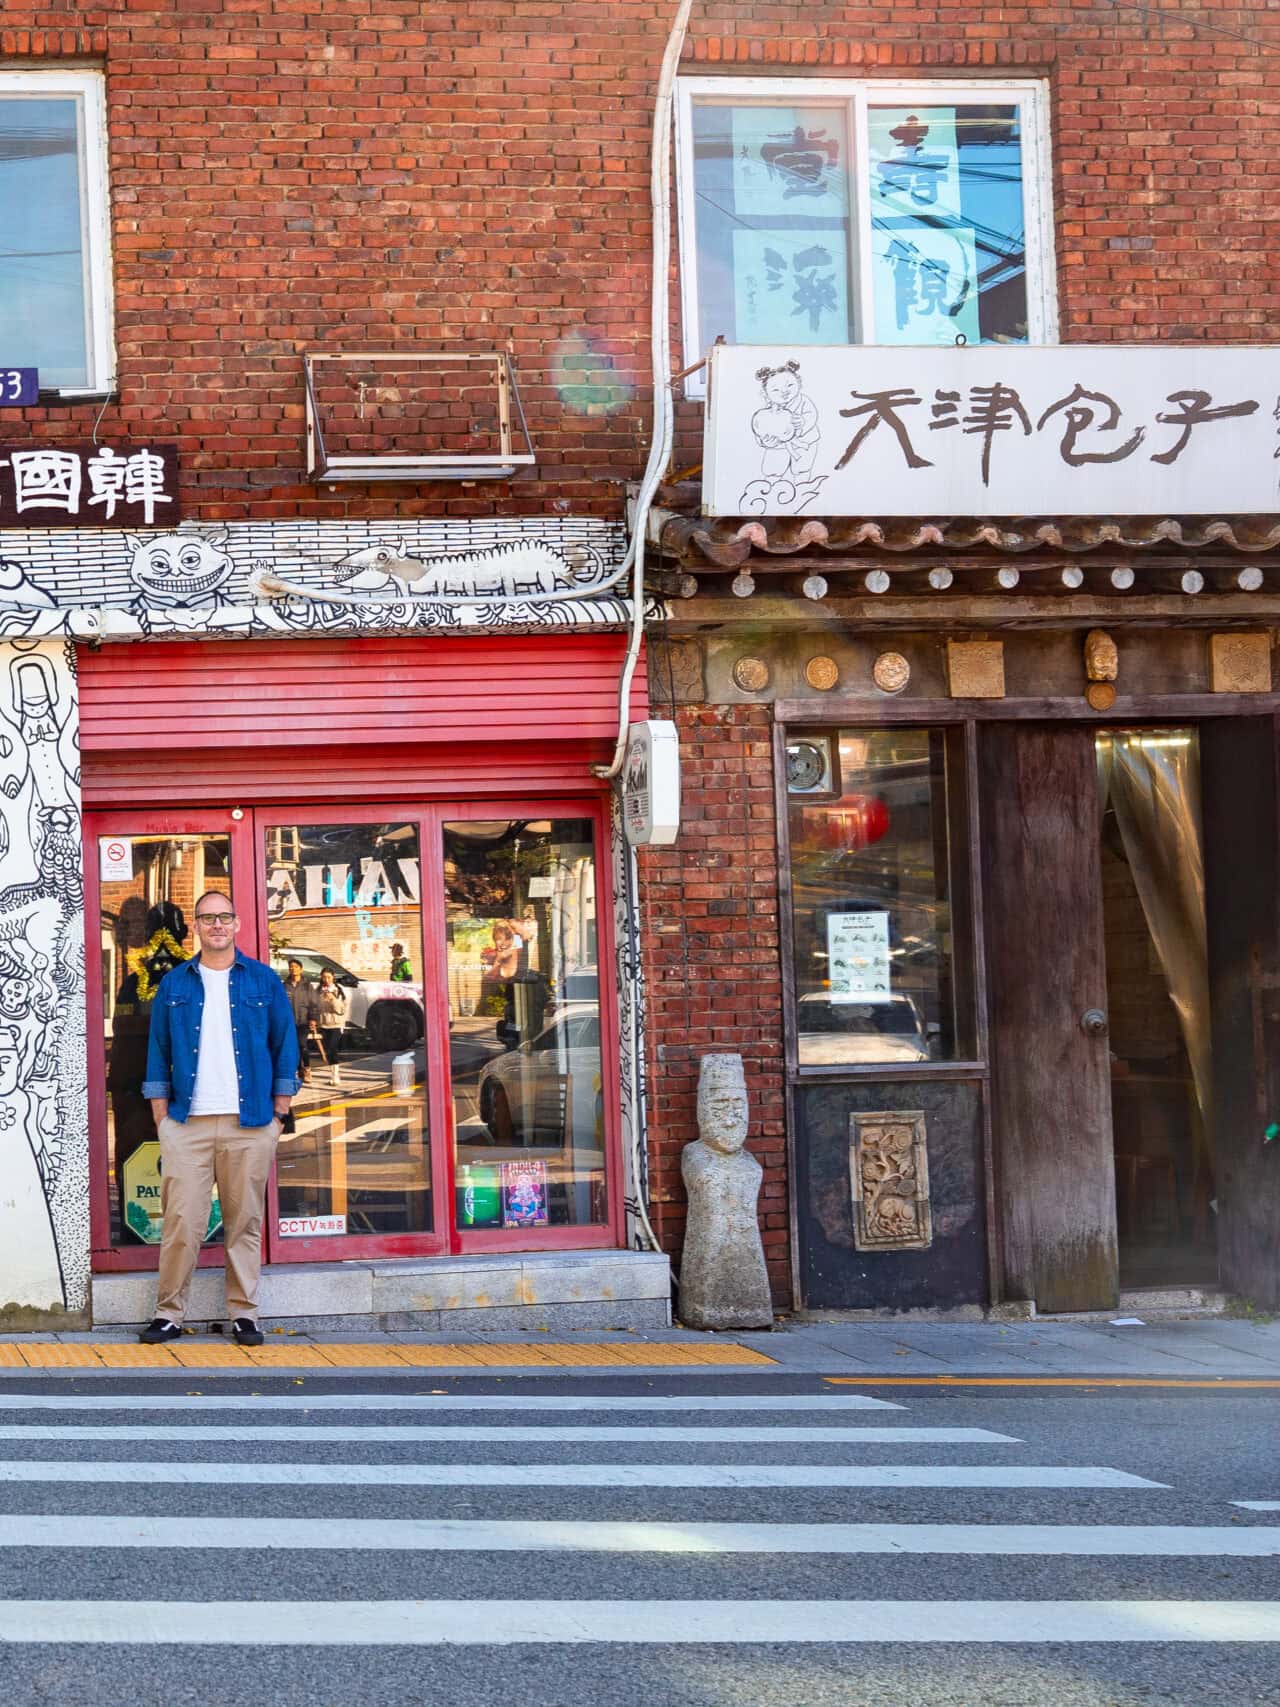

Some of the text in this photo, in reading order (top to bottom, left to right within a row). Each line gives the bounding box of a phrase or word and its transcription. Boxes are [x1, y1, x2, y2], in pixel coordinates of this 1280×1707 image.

[834, 382, 1260, 488] 天津包子
[279, 1219, 318, 1233] CCTV
